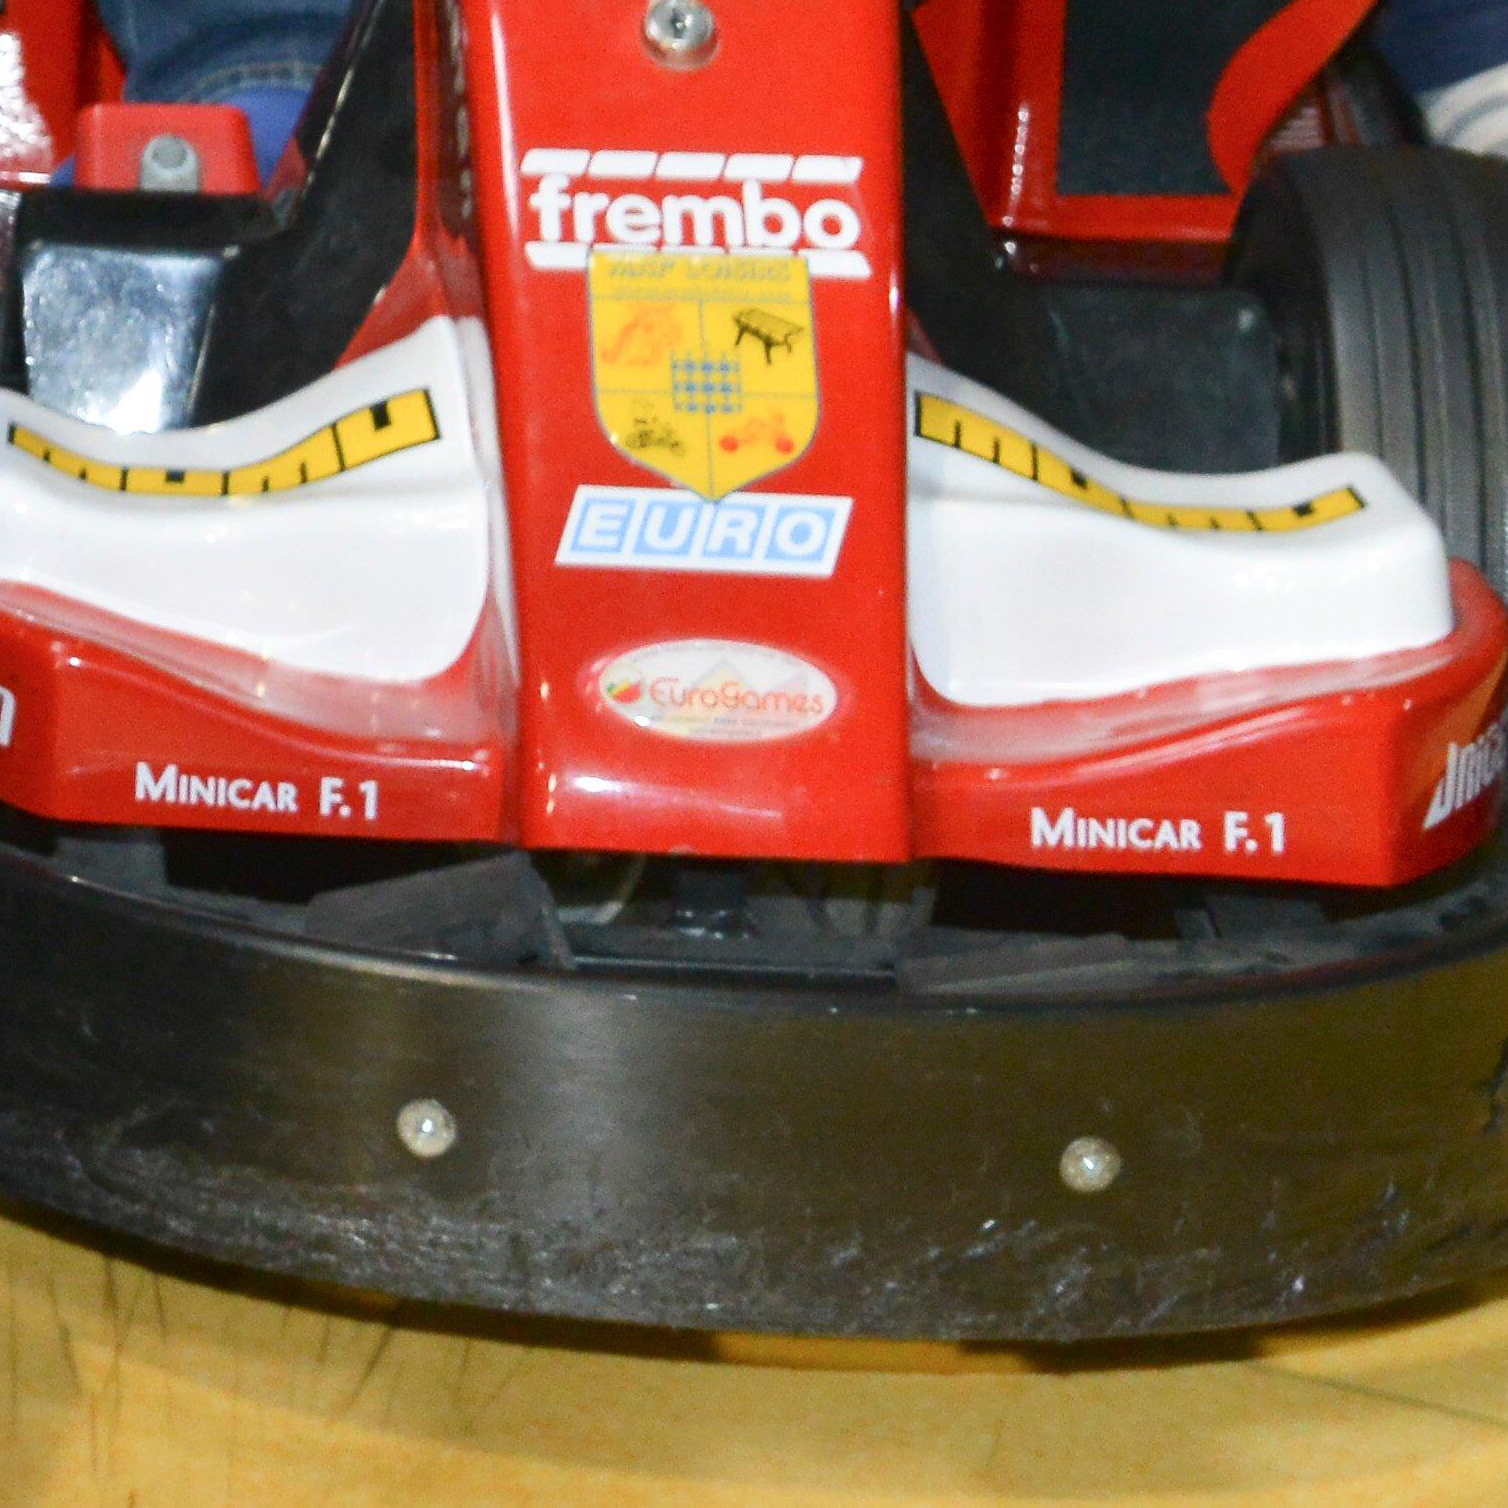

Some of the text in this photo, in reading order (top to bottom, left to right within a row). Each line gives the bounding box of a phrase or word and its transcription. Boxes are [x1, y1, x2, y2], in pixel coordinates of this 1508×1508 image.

[529, 173, 862, 250] frembo
[576, 503, 832, 560] EURO
[318, 778, 379, 819] F.1
[1225, 811, 1286, 855] F.1
